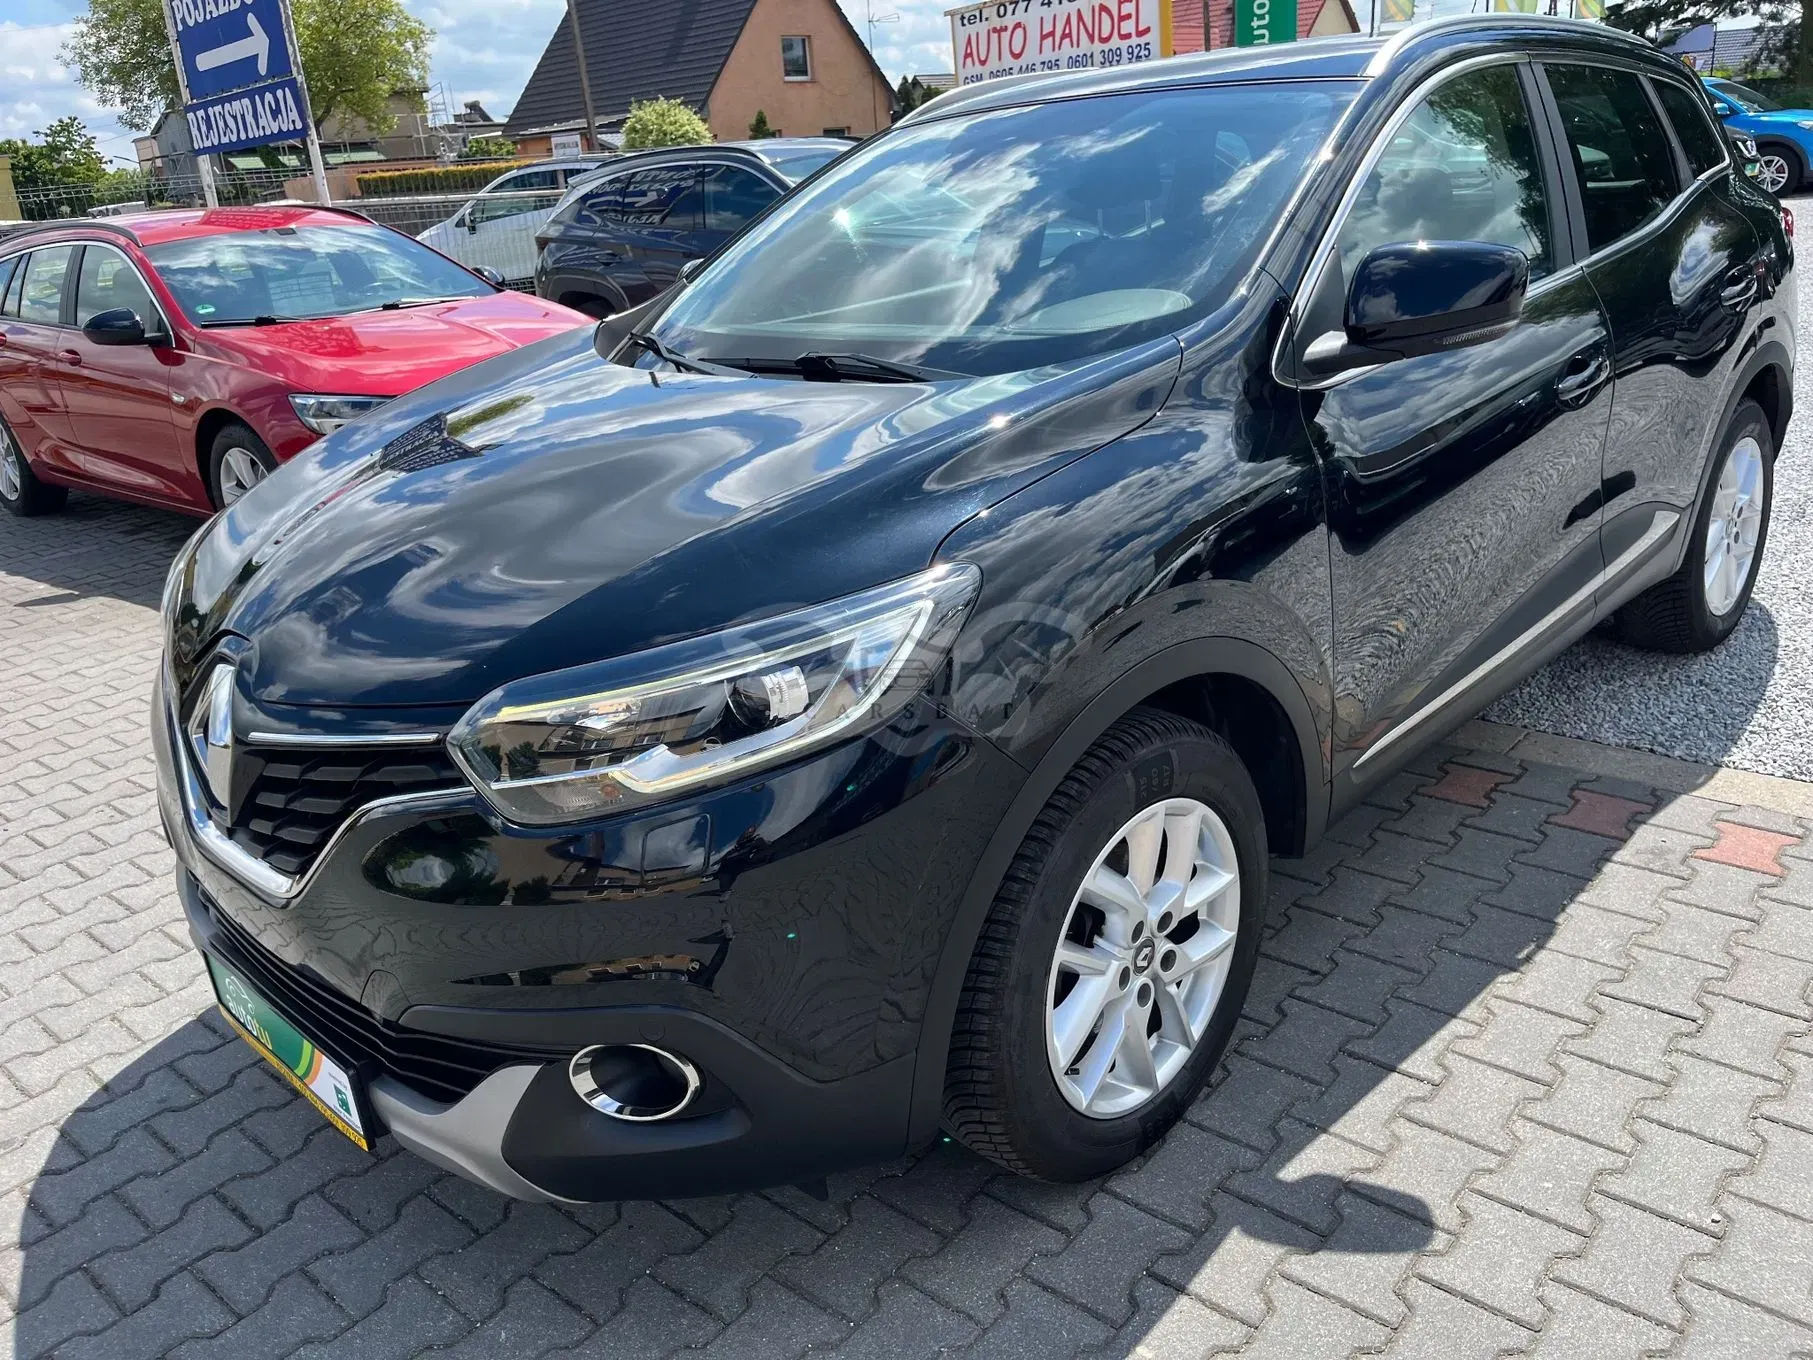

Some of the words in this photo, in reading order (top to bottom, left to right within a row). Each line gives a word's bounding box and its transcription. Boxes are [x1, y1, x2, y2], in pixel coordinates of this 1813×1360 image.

[960, 9, 989, 27] tel.
[996, 0, 1031, 18] 077
[963, 22, 1027, 69] AUTO
[1039, 0, 1151, 54] HANDEL
[1067, 51, 1095, 70] 0601
[1099, 47, 1122, 65] 309
[1127, 41, 1151, 61] 925
[186, 87, 303, 150] REJESTRACJA
